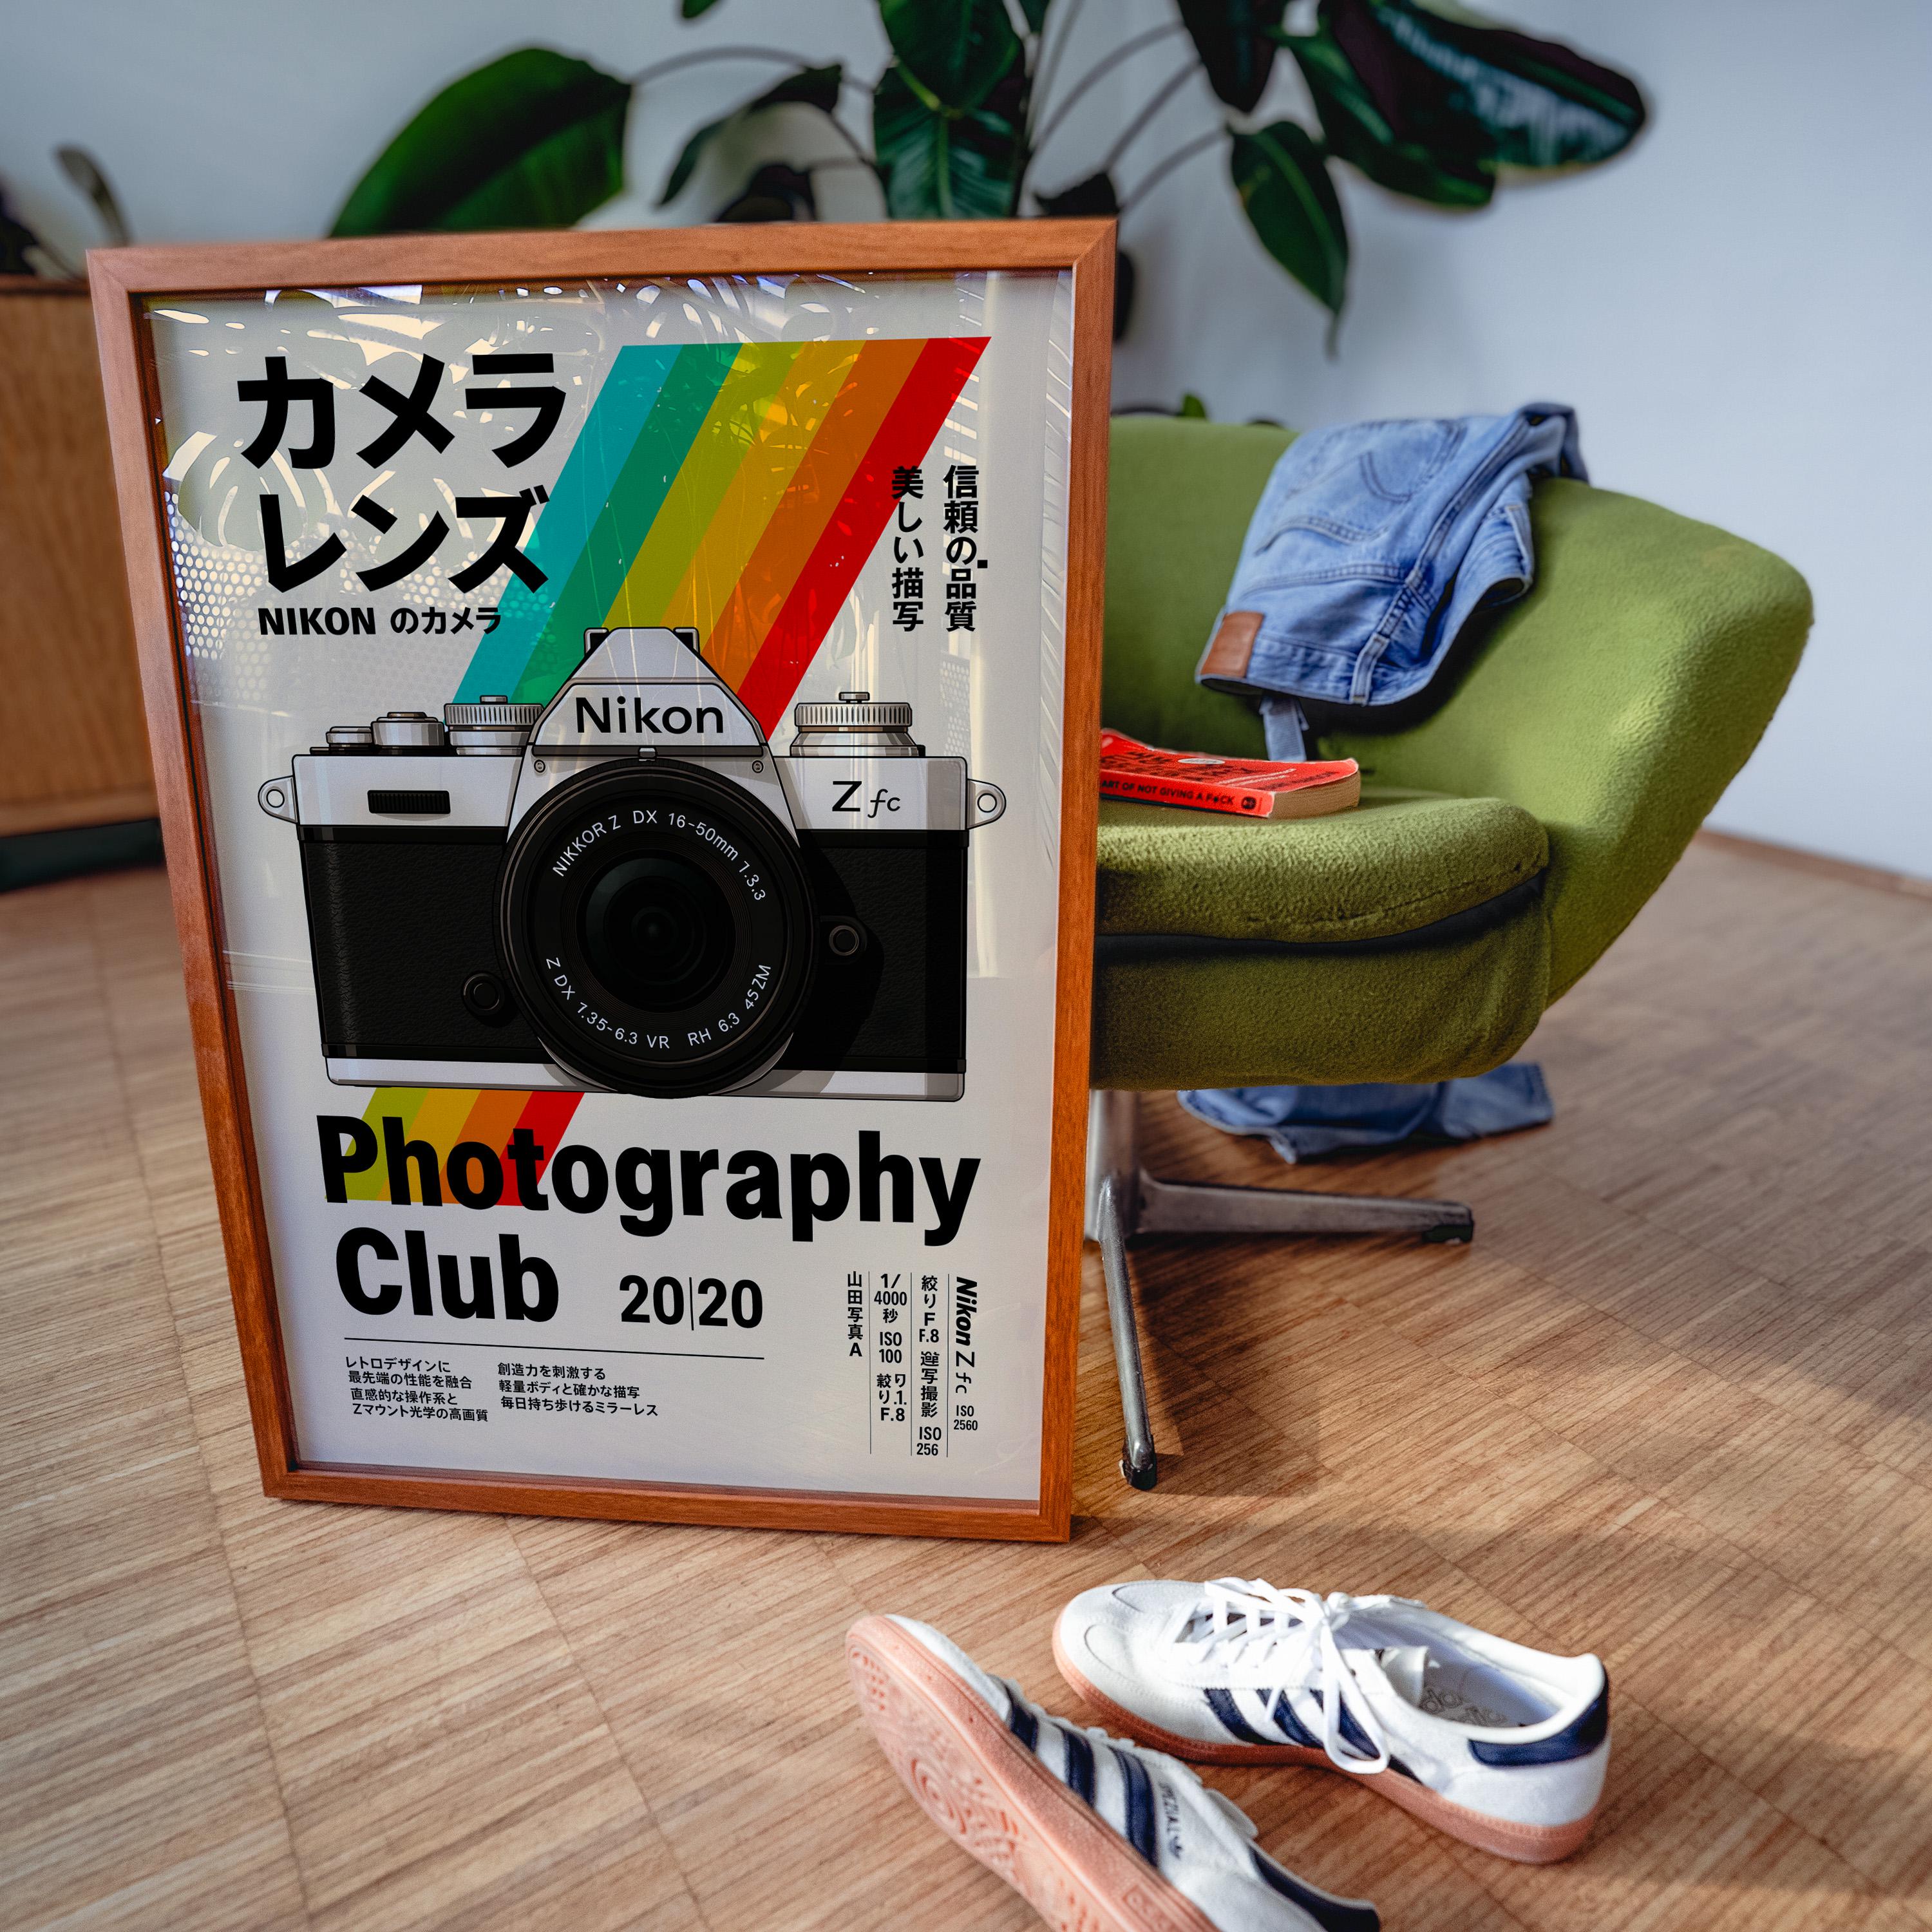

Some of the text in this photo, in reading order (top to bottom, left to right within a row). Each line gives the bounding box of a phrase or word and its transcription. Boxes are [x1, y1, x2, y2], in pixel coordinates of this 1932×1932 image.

[238, 353, 566, 469] カメラ
[260, 485, 550, 593] レンズ
[892, 466, 923, 632] 美しい描写
[943, 465, 979, 632] 信頼の品質
[259, 607, 501, 635] NIKON のカメラ
[577, 696, 723, 734] Nikon
[1102, 780, 1120, 789] ART
[1137, 784, 1157, 793] NOT
[1160, 786, 1194, 799] GIVING
[832, 781, 901, 819] Z fc
[553, 822, 607, 877] NIKKOR
[608, 815, 620, 830] Z
[633, 810, 658, 824] DX
[668, 813, 739, 861] 16-50mm
[546, 957, 561, 969] Z
[554, 974, 575, 1000] DX
[647, 1034, 670, 1049] VR
[687, 1030, 712, 1046] RH
[718, 1012, 740, 1032] 6.3
[317, 1114, 981, 1247] Photography
[335, 1226, 559, 1323] Club
[956, 1276, 978, 1347] Nikon
[880, 1331, 902, 1346] ISO
[346, 1356, 451, 1373] レトロデザインに
[878, 1349, 902, 1363] 100
[956, 1350, 975, 1368] Z
[348, 1370, 472, 1389] 最先端の性能を融合
[497, 1362, 606, 1380] 創造力を刺激する
[350, 1387, 458, 1405] 直感的な操作系と
[498, 1379, 640, 1399] 軽量ボディと確かな描写
[352, 1403, 488, 1422] Zマウント光学の高画質
[500, 1396, 658, 1416] 毎日持ち歩けるミラーレス
[956, 1405, 974, 1417] ISO
[919, 1426, 942, 1441] ISO
[953, 1419, 978, 1431] 2560
[916, 1443, 939, 1455] 256
